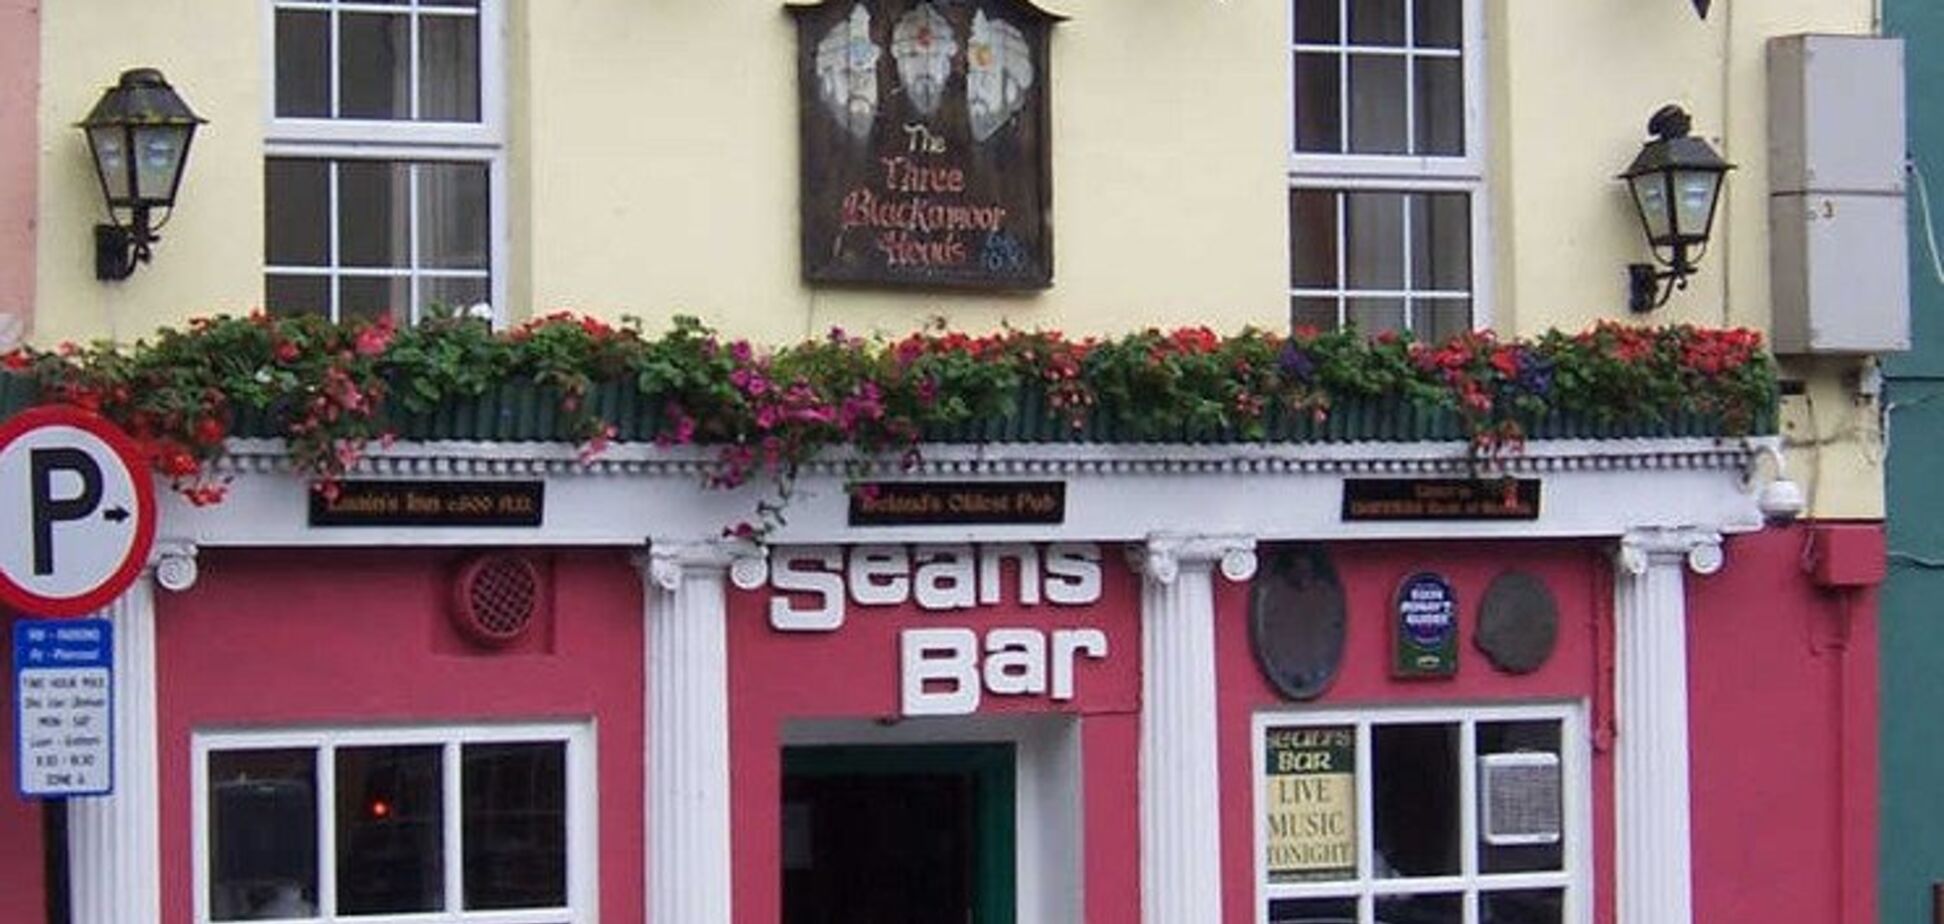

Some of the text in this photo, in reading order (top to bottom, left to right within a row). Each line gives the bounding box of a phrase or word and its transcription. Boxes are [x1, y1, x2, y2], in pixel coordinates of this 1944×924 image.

[903, 123, 947, 153] The
[881, 156, 965, 192] Three
[842, 188, 1007, 234] Blackamoor
[30, 447, 104, 576] P
[949, 492, 1009, 512] Oldest
[1015, 492, 1056, 513] Pub
[770, 543, 1102, 631] Seans
[901, 627, 1108, 715] Bar
[1278, 750, 1333, 772] BAR
[1279, 778, 1332, 804] LIVE
[1268, 811, 1346, 838] MUSIC
